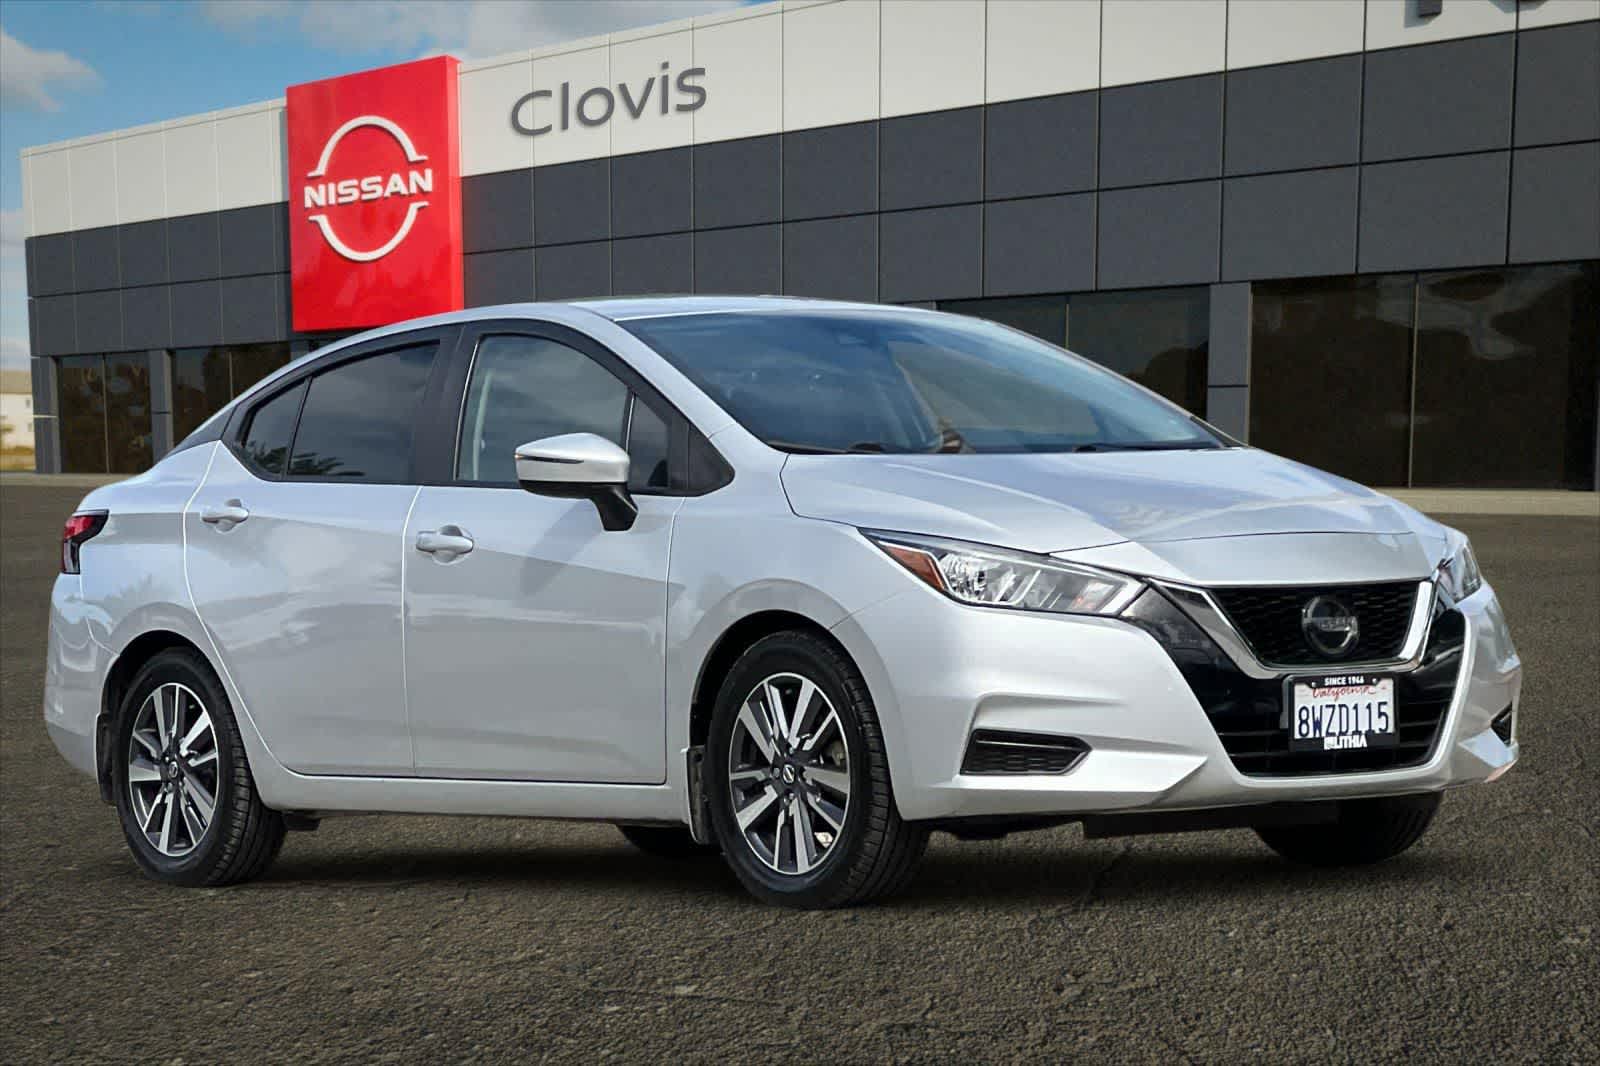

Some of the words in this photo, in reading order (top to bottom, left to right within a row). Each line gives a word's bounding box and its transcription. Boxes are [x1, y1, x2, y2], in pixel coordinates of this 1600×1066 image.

[511, 61, 707, 136] Clovis
[304, 168, 433, 208] NISSAN
[1324, 676, 1347, 686] SINCE
[1298, 701, 1389, 738] 8WZD115
